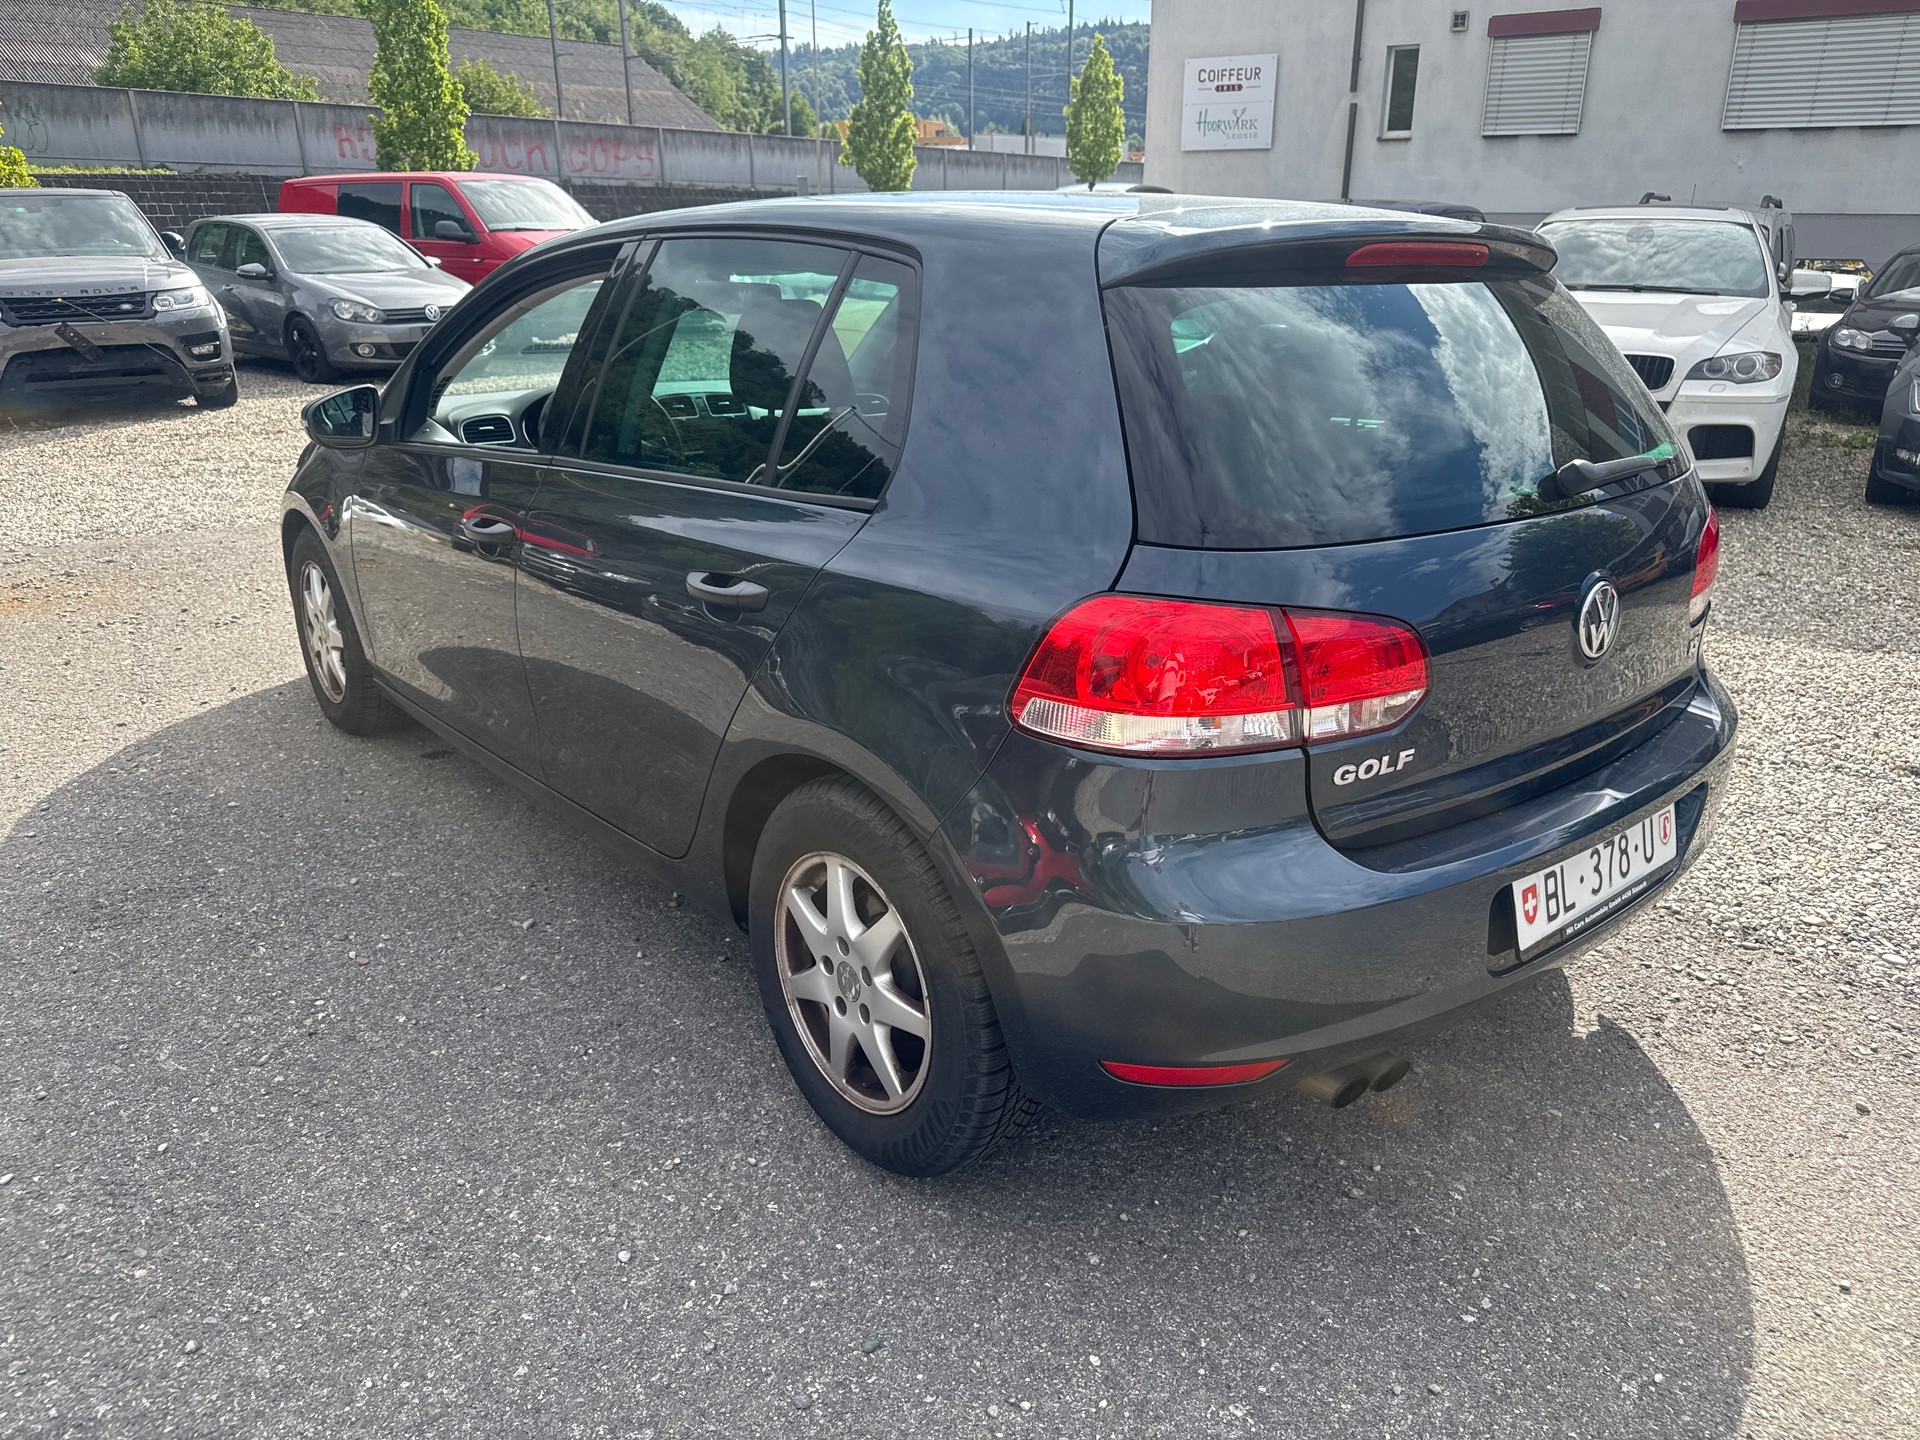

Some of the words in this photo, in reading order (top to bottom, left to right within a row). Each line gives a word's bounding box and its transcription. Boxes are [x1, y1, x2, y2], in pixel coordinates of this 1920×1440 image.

[1198, 67, 1262, 83] COIFFEUR
[1333, 748, 1416, 786] GOLF
[1573, 921, 1585, 930] Cars
[1585, 905, 1609, 923] Automobile
